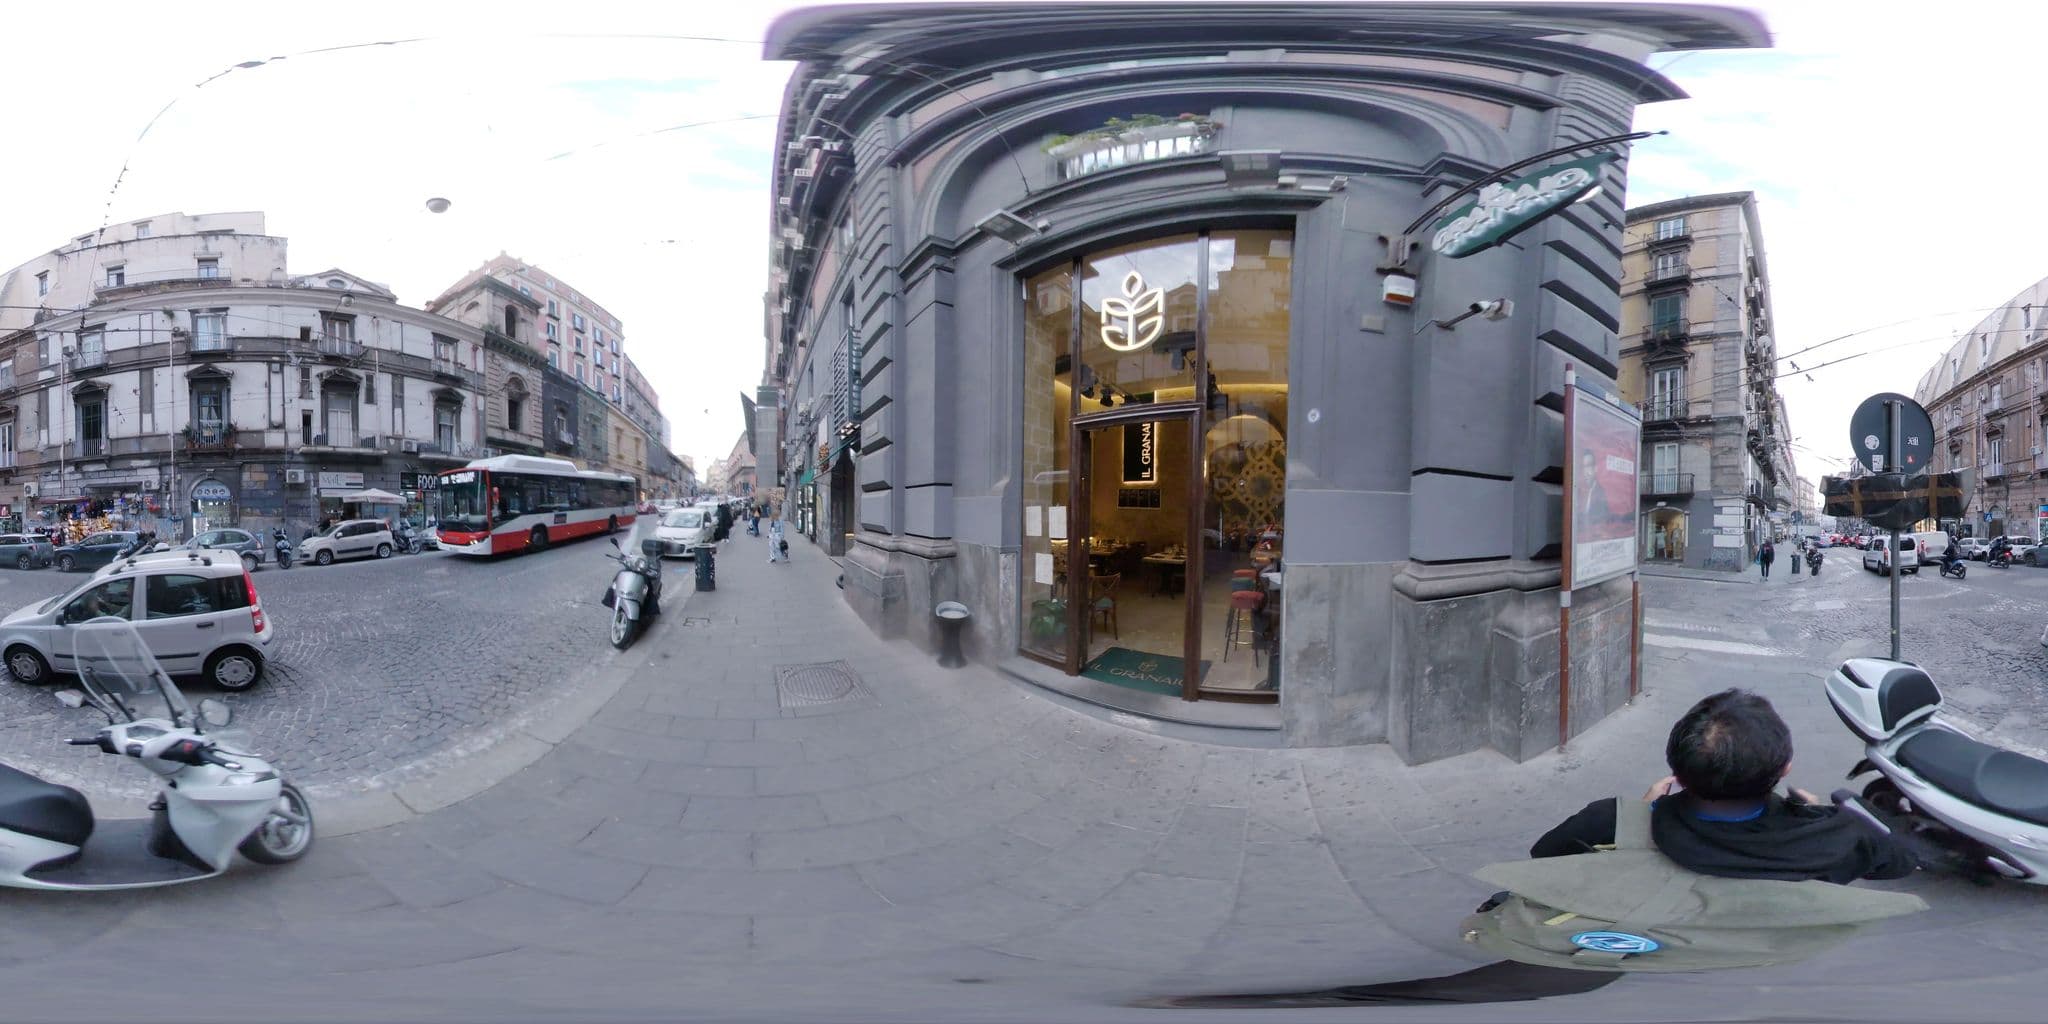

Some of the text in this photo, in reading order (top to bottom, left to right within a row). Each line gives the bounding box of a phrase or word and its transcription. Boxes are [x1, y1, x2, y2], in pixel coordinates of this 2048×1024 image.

[1141, 422, 1151, 478] IL GRANAI
[1090, 663, 1104, 672] IL
